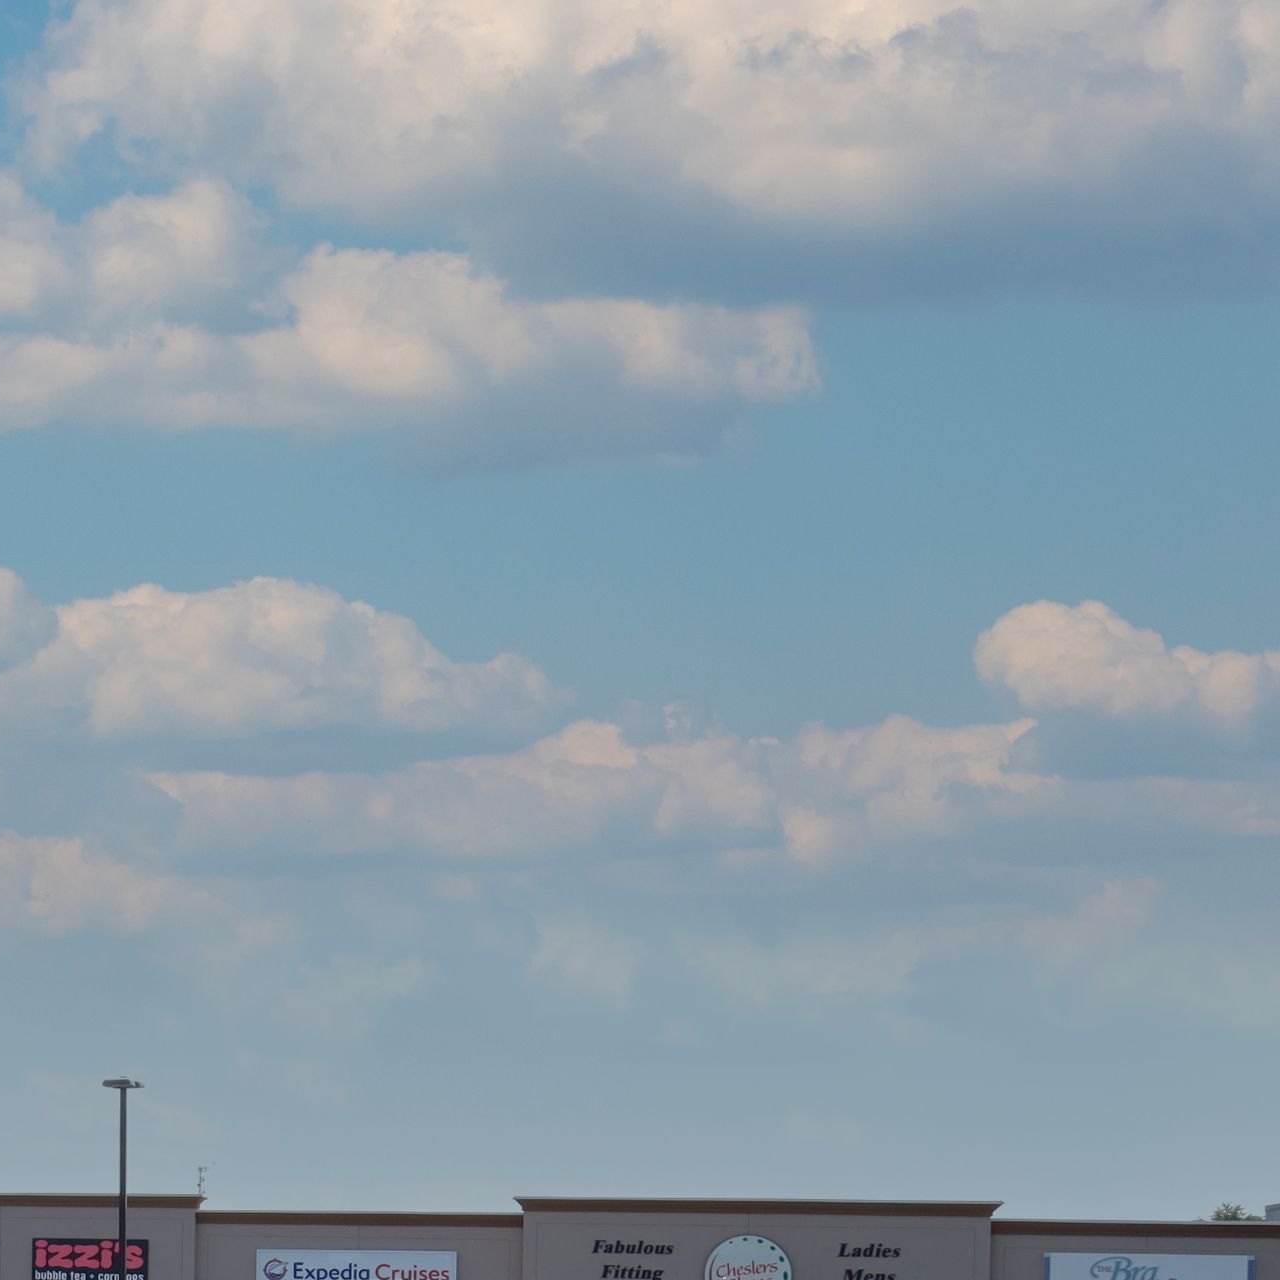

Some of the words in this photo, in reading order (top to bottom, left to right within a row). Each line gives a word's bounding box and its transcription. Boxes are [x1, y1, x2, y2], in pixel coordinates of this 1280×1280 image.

[34, 1239, 144, 1270] izzi's
[591, 1239, 674, 1255] Fabulous
[838, 1243, 901, 1258] Ladies
[35, 1270, 68, 1280] bubble
[716, 1260, 779, 1278] Cheslers
[1096, 1265, 1113, 1273] THE
